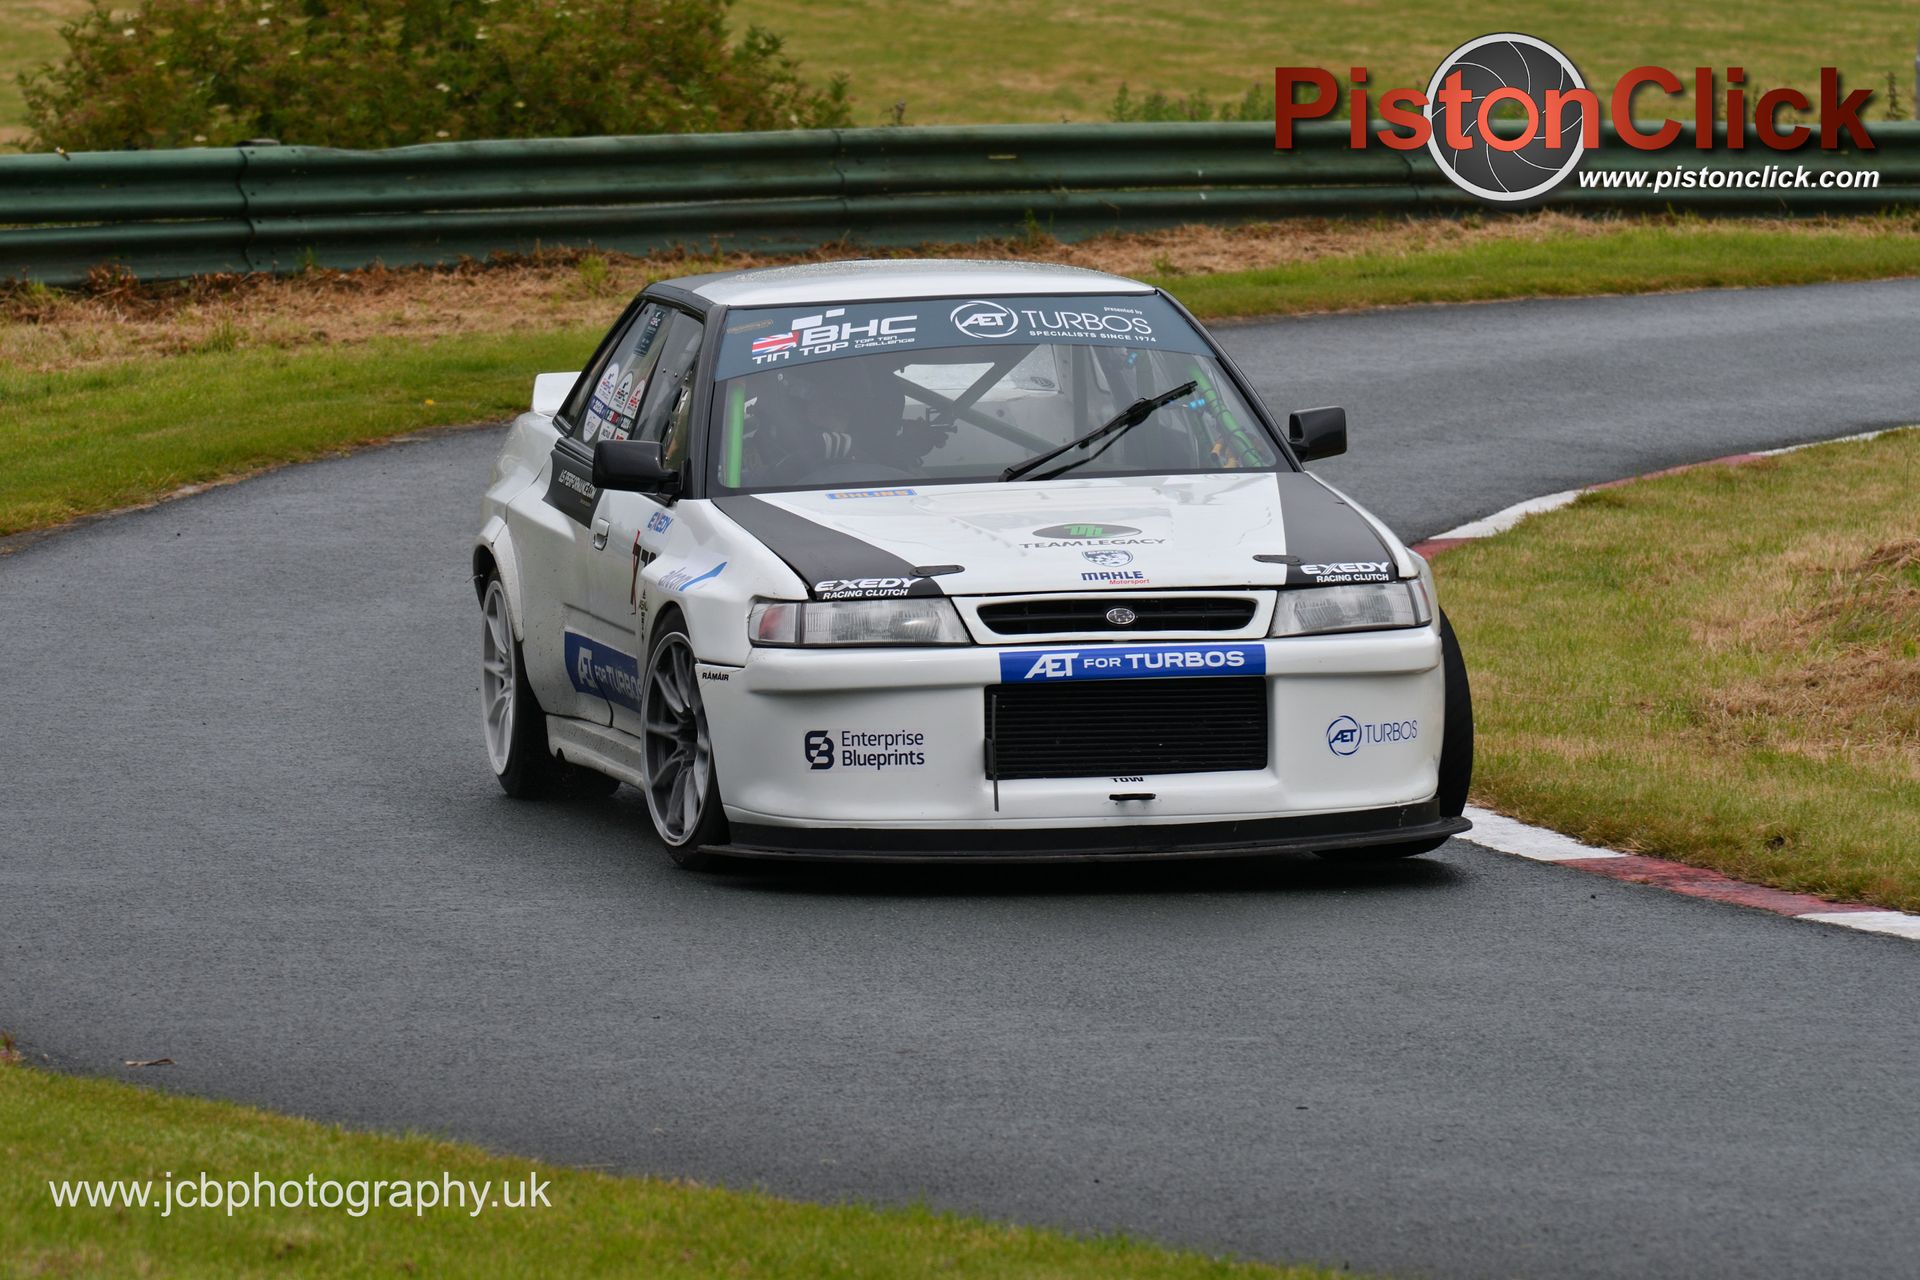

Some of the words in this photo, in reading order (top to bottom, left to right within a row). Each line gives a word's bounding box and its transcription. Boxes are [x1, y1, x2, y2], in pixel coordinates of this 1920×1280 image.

[1103, 305, 1133, 315] presented
[1021, 310, 1153, 335] TURBOS
[802, 315, 918, 347] BHC
[1029, 330, 1097, 339] SPECIALISTS
[1100, 333, 1132, 341] SINCE
[1135, 335, 1157, 343] 1974
[800, 341, 850, 357] TOP
[1019, 540, 1083, 549] TEAM
[1087, 538, 1167, 546] LEGACY
[1081, 570, 1144, 581] MAHLE
[1300, 561, 1390, 575] EXEDY
[814, 577, 925, 592] EXEDY
[1316, 574, 1352, 583] RACING
[1353, 573, 1389, 582] CLUTCH
[823, 590, 862, 600] RACING
[865, 588, 909, 597] CLUTCH
[1083, 657, 1121, 669] FOR
[1125, 651, 1245, 669] TURBOS
[1364, 719, 1418, 744] TURBOS
[841, 729, 924, 750] Enterprise
[842, 749, 925, 770] Blueprints
